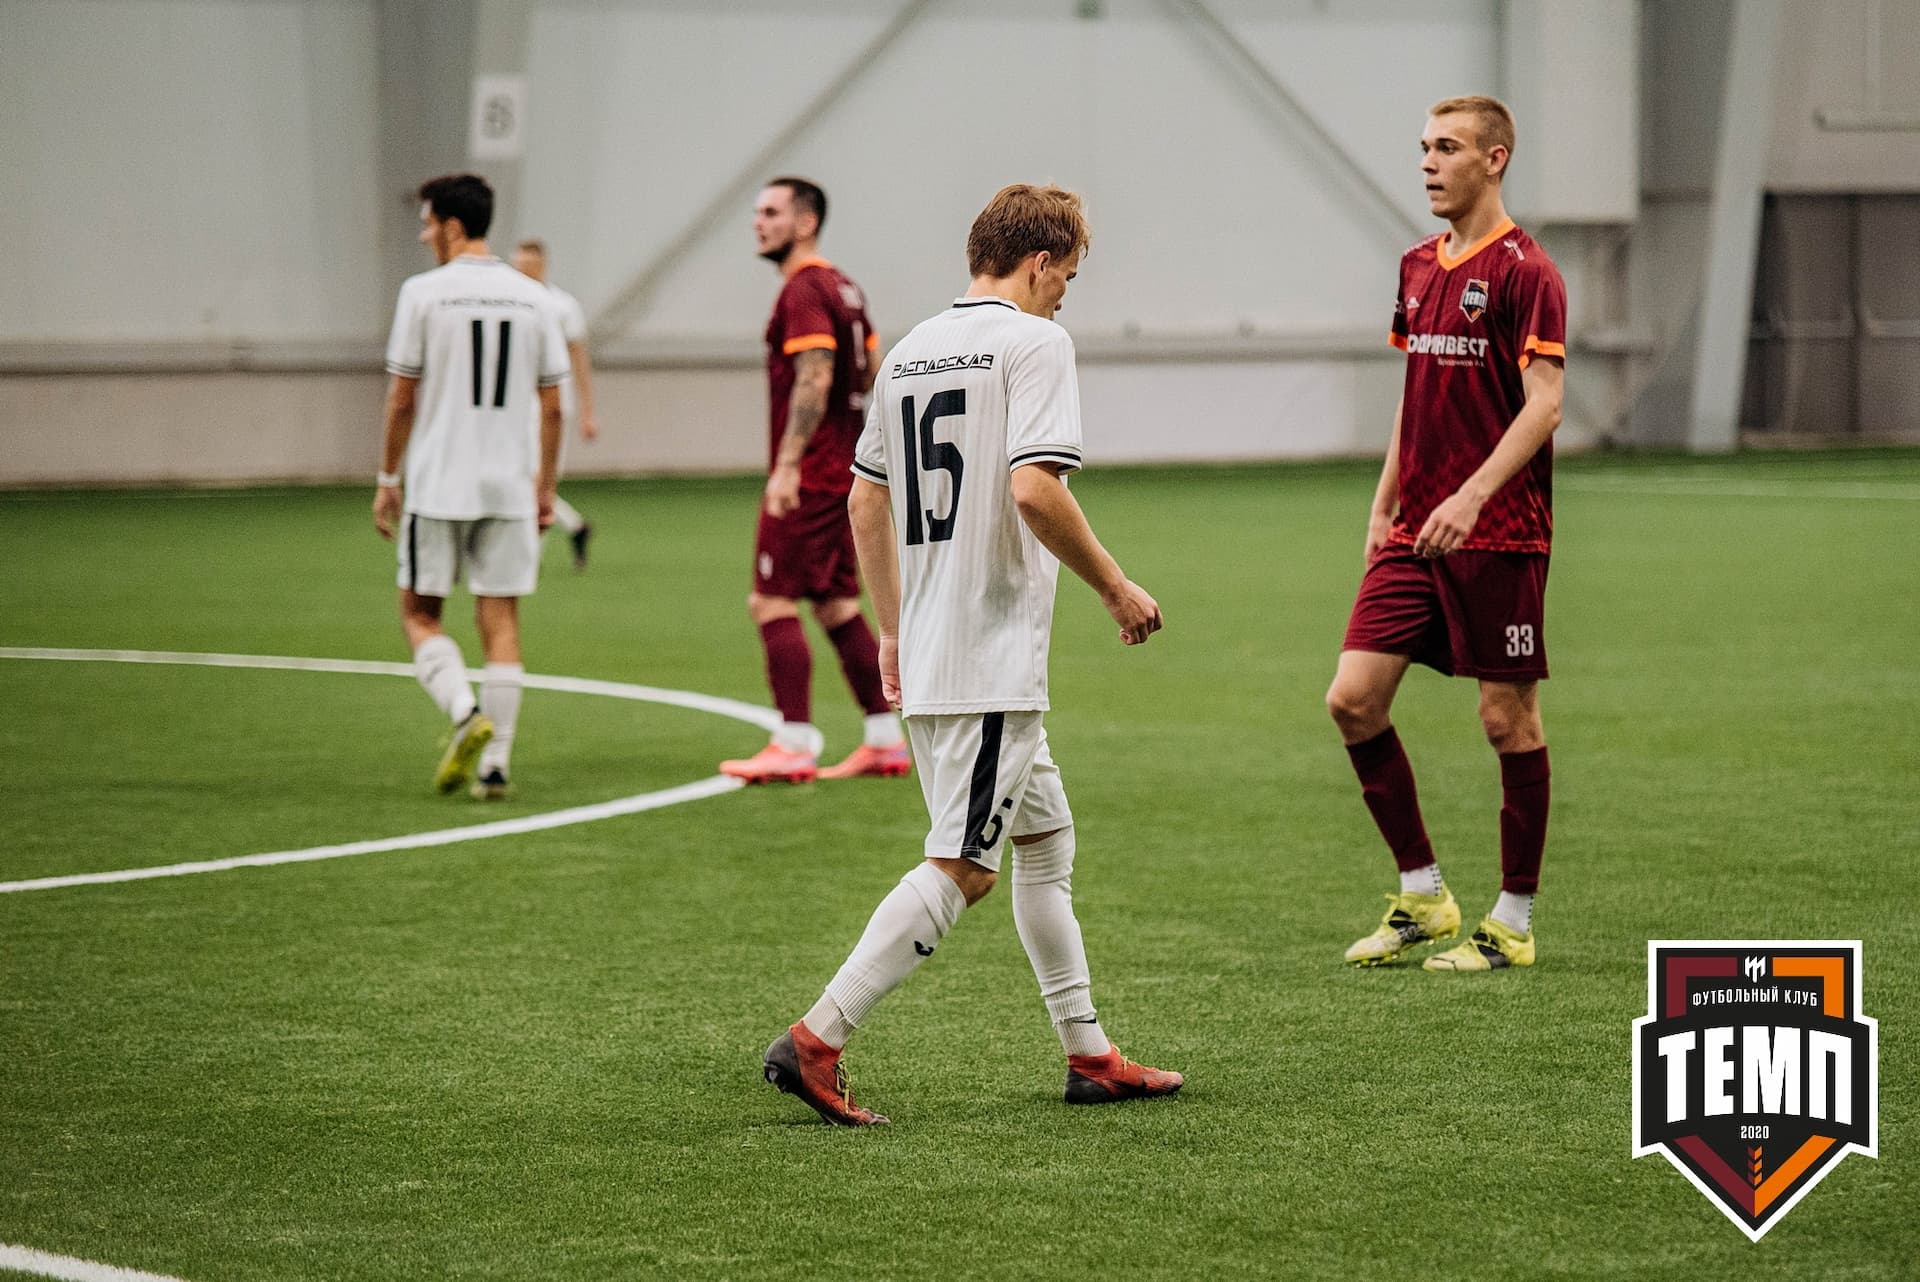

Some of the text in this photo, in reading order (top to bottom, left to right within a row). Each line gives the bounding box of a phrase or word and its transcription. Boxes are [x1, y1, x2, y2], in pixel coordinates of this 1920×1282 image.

[471, 320, 510, 407] 11
[901, 388, 966, 545] 15
[1505, 624, 1534, 657] 33
